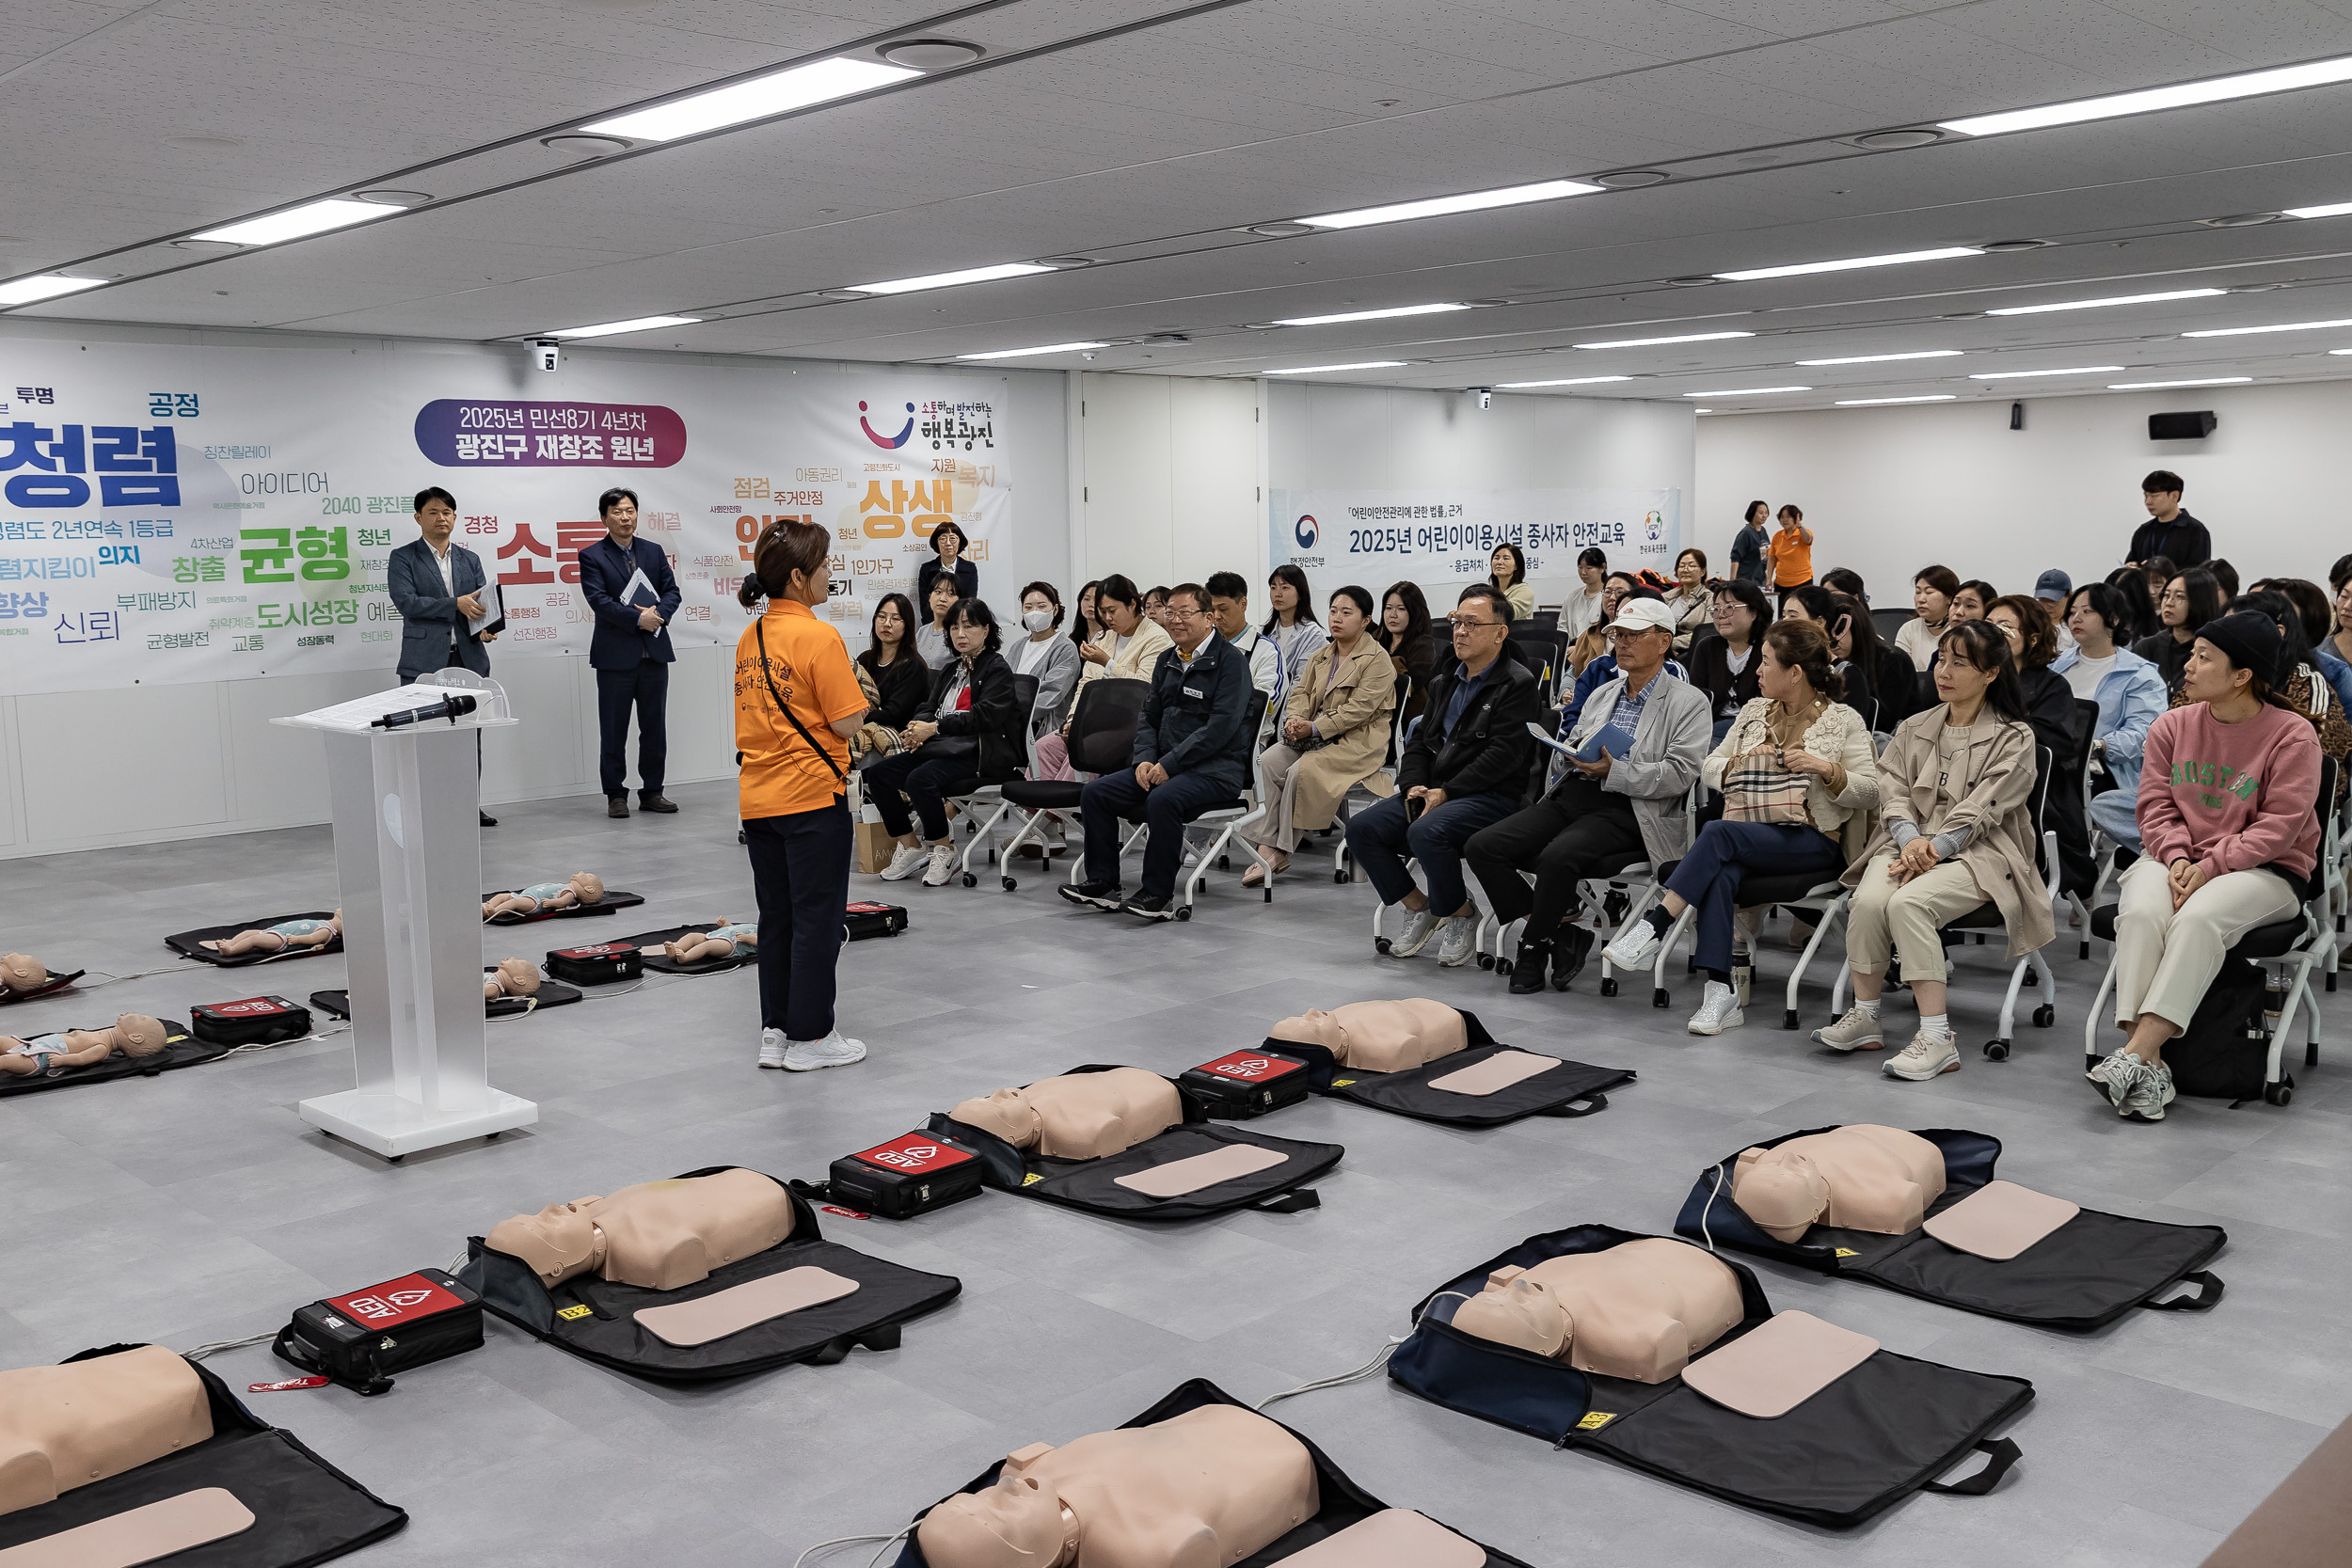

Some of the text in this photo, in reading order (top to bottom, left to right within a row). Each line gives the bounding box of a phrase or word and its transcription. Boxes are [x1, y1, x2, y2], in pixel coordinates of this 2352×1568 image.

[16, 387, 55, 404] 투명
[149, 392, 199, 418] 공정
[922, 401, 993, 420] 소통하며 발전하는
[460, 406, 646, 432] 2025년 민선8기 4년차
[921, 418, 994, 451] 행복광진
[203, 445, 272, 460] 칭찬릴레이
[455, 433, 655, 462] 광진구 재창조 원년
[0, 421, 181, 508] 청렴
[863, 463, 900, 472] 고령친화도시
[930, 458, 956, 473] 지원
[241, 472, 329, 495] 아이디어
[795, 467, 843, 483] 아동권리
[958, 465, 995, 488] 복지
[734, 477, 771, 499] 점검
[322, 497, 361, 515] 2040
[773, 490, 823, 506] 주거안정
[860, 479, 954, 539] 상생
[1413, 505, 1428, 519] 관한
[52, 520, 123, 540] 2년연속
[129, 519, 174, 538] 1등급
[464, 515, 499, 534] 경청
[647, 512, 682, 531] 해결
[358, 528, 391, 546] 청년
[837, 527, 858, 540] 청년
[1349, 521, 1626, 554] 2025년 어린이이용시설 종사자 안전교육
[190, 537, 234, 549] 4차산업
[902, 543, 928, 553] 소상공인
[98, 545, 141, 565] 의지
[240, 526, 351, 584] 균형
[692, 555, 734, 567] 식품안전
[1525, 557, 1539, 570] 중심
[172, 556, 226, 583] 창출
[850, 558, 895, 576] 1인가구
[1454, 558, 1485, 573] 응급처치
[117, 591, 197, 612] 부패방지
[545, 592, 571, 607] 공감
[258, 599, 359, 628] 도시성장
[685, 605, 711, 622] 연결
[829, 599, 864, 622] 활력
[54, 610, 119, 644] 신뢰
[360, 629, 393, 643] 현대화
[513, 626, 558, 641] 선진행정
[147, 631, 210, 650] 균형발전
[231, 634, 264, 652] 교통
[296, 634, 335, 647] 성장동력
[2170, 760, 2259, 800] BOSTON
[1216, 1065, 1262, 1077] AED
[874, 1152, 924, 1167] AED
[348, 1297, 397, 1319] AED
[1581, 1413, 1609, 1427] A3
